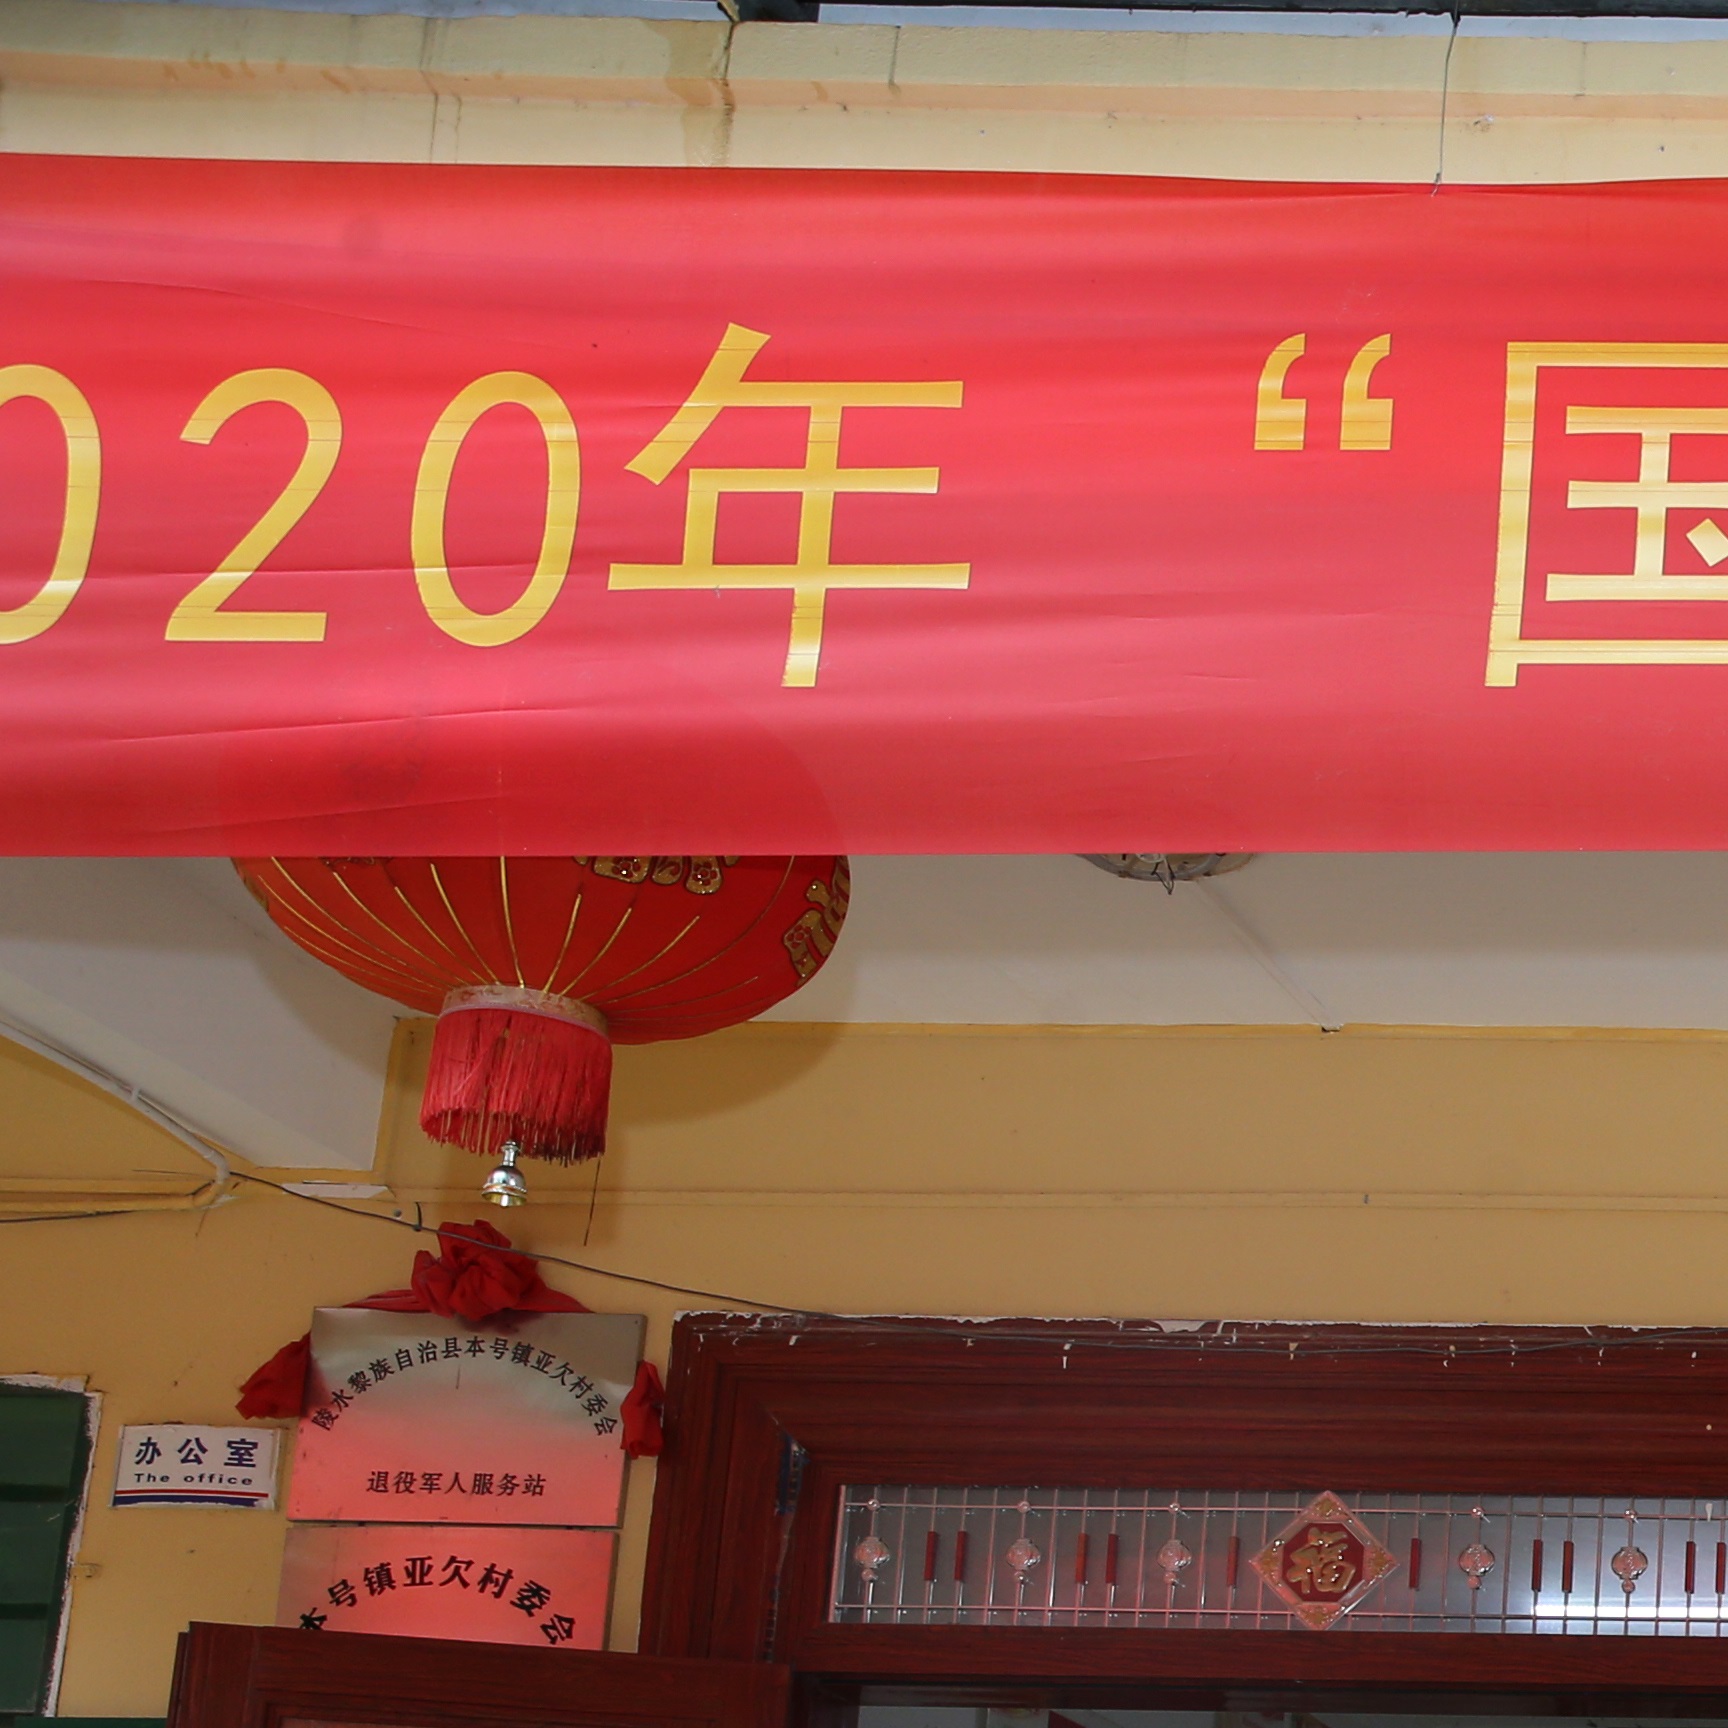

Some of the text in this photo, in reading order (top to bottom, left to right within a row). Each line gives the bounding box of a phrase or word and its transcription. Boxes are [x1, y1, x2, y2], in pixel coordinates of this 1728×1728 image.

[311, 1335, 618, 1436] 陵水黎族自治县本号镇亚欠村委会
[134, 1436, 259, 1468] 办公室
[134, 1473, 253, 1486] The office
[366, 1470, 546, 1497] 退役军人服务站
